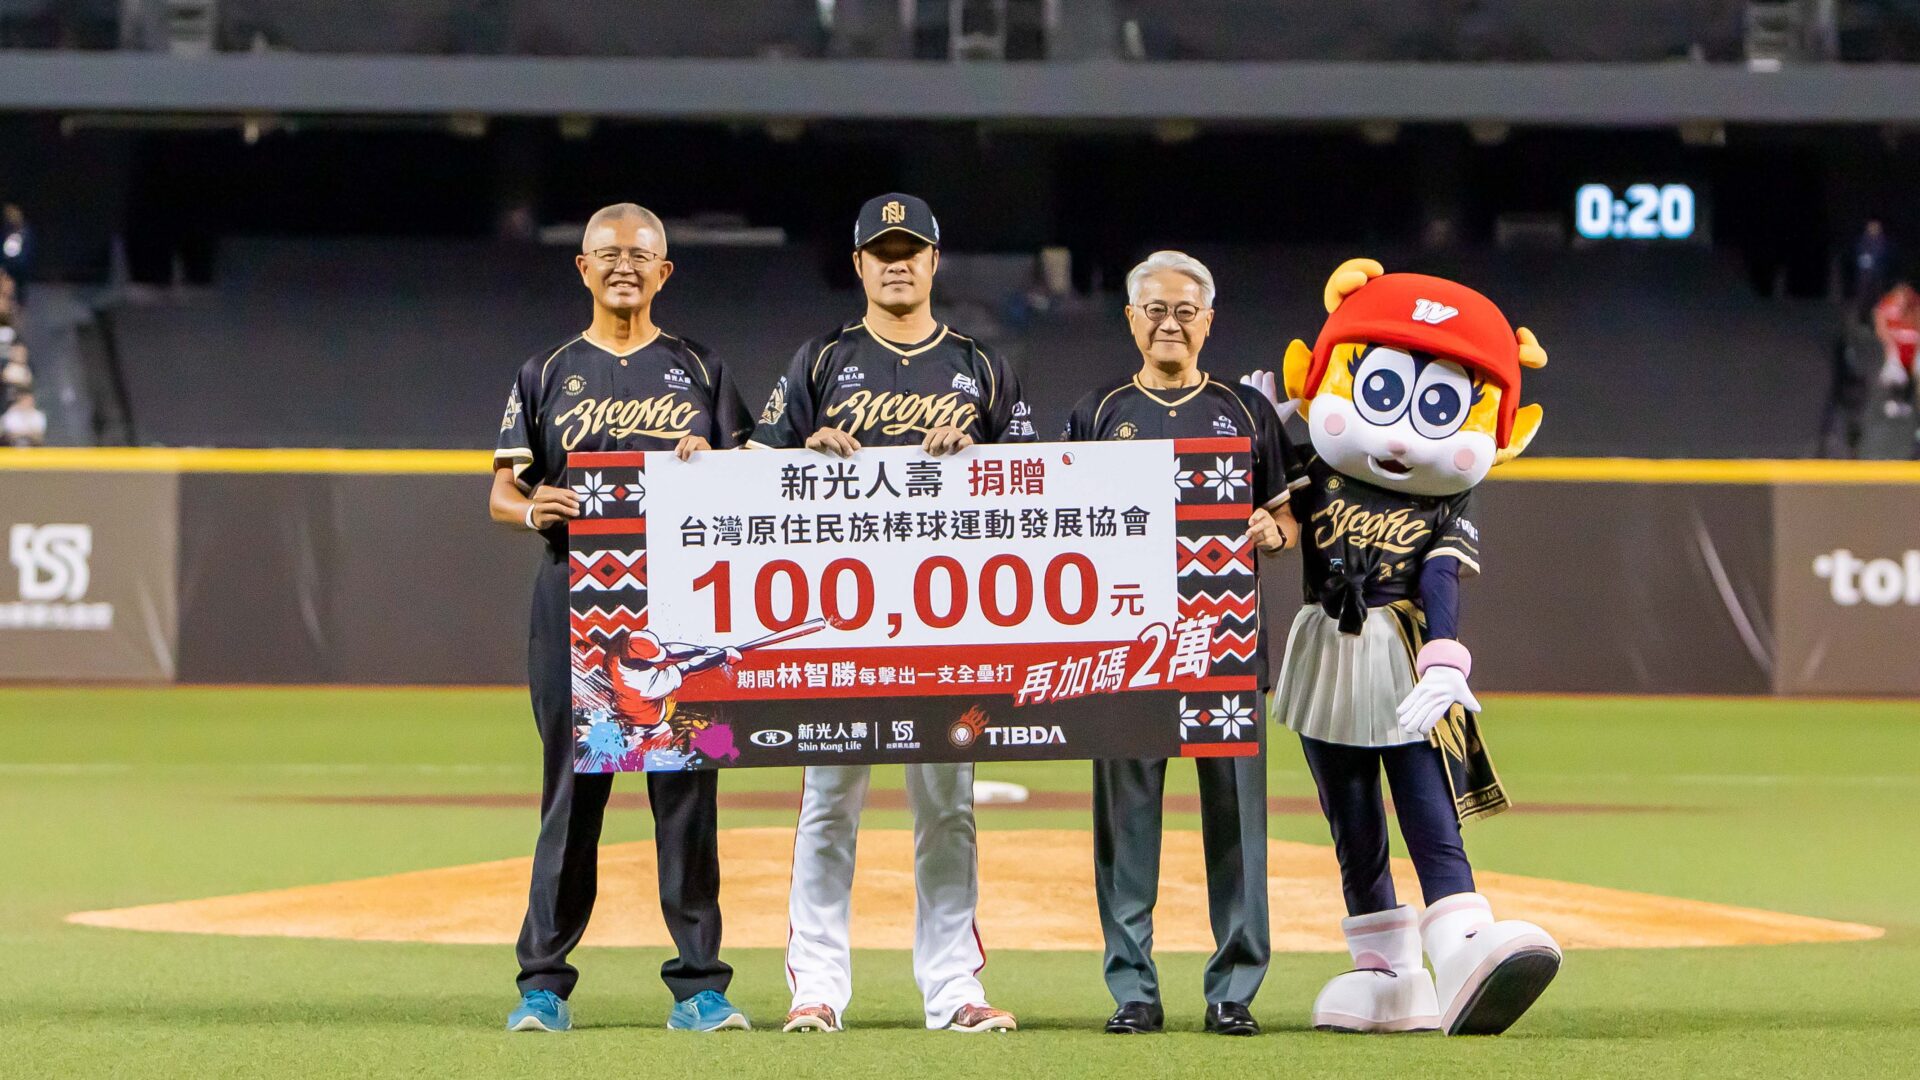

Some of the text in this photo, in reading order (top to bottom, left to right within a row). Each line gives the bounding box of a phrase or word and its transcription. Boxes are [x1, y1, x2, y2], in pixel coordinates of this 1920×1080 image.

[1576, 183, 1695, 239] 0:20
[952, 381, 980, 397] RACIN
[1009, 420, 1036, 436] 王道
[781, 457, 1046, 501] 新光人壽 捐贈
[680, 506, 1151, 547] 台灣原住民族棒球運動發展協會
[692, 552, 1145, 638] 100,000 元
[1018, 611, 1219, 704] 再加碼2萬
[737, 660, 1014, 689] 期間林智勝每擊出一支全壘打
[798, 722, 868, 740] 新光人壽
[984, 725, 1067, 745] TIBDA
[798, 741, 862, 752] Shin Kong Life
